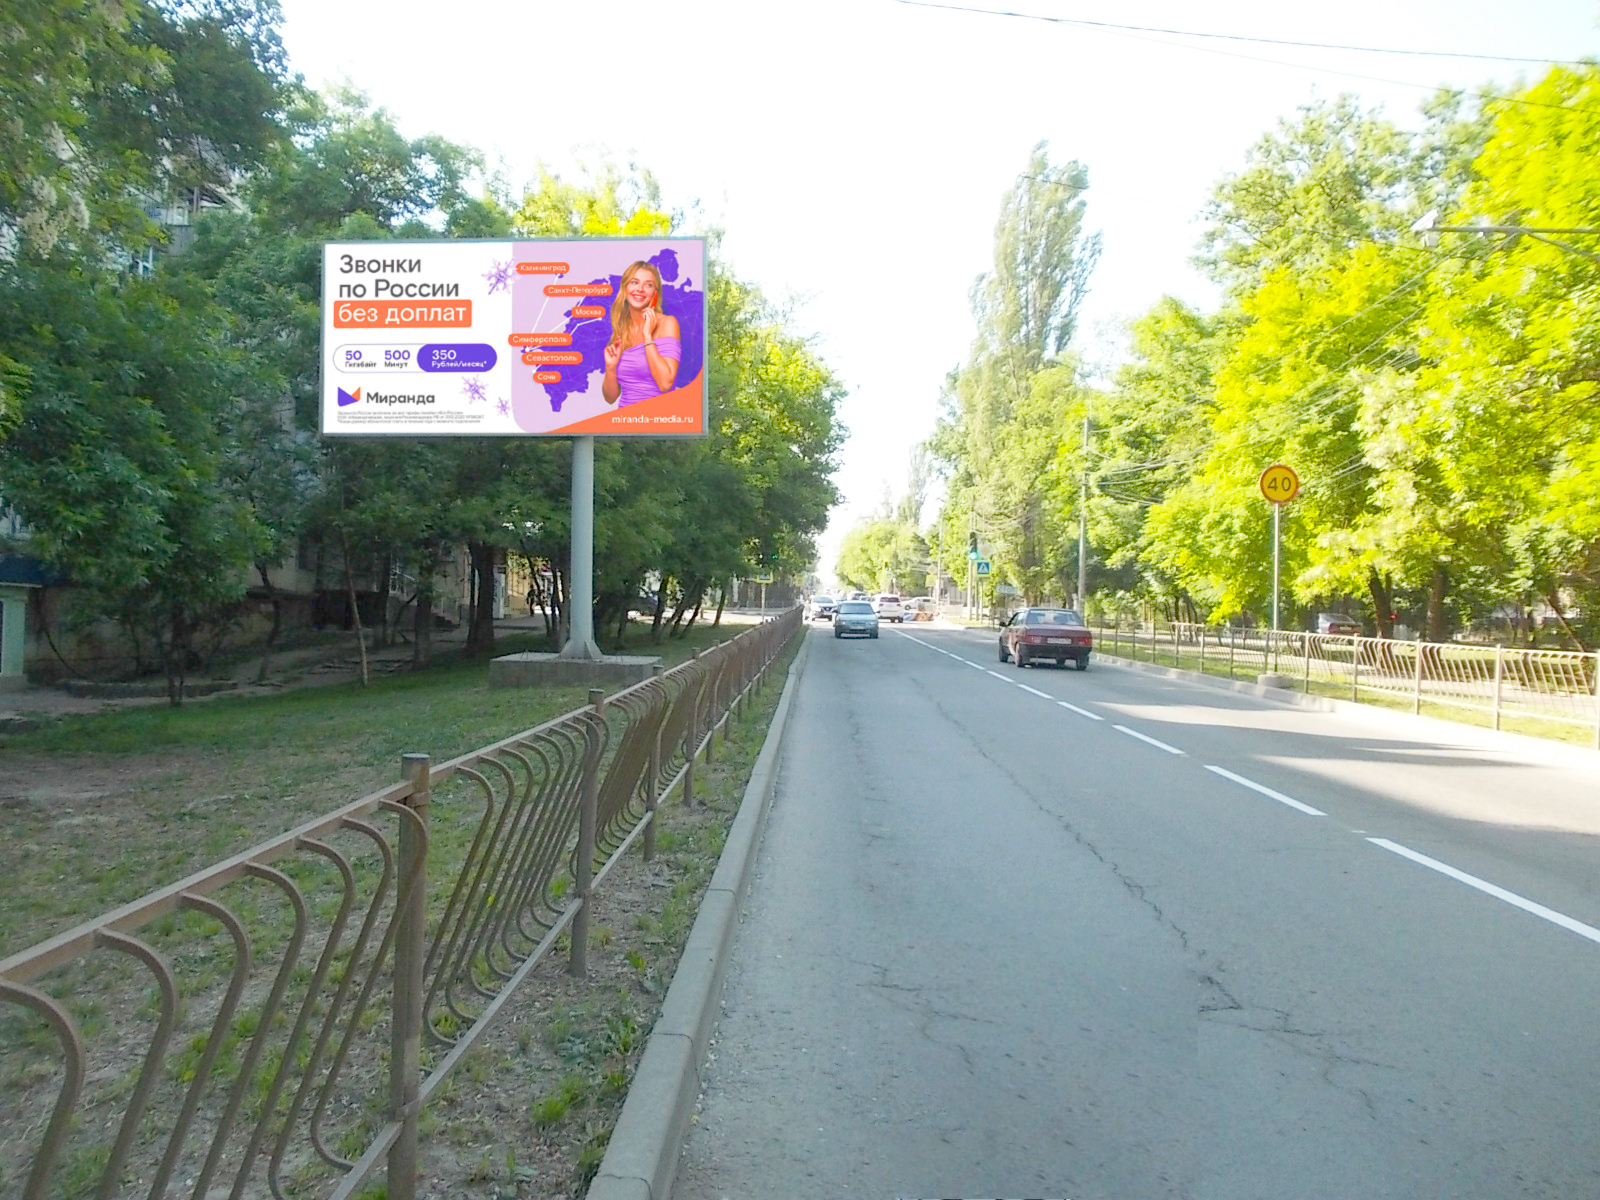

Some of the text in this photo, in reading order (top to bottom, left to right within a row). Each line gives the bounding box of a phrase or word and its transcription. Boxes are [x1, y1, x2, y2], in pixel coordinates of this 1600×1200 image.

[339, 254, 421, 273] Звонки
[520, 263, 566, 272] Калининград
[339, 279, 459, 298] по России
[548, 286, 609, 295] Санкт-Петербург
[338, 303, 467, 325] без доплат
[575, 308, 602, 316] Москва
[512, 335, 567, 345] Симферополь
[345, 349, 457, 361] 50 500 350
[526, 353, 577, 362] Севастополь
[384, 361, 408, 369] Минут
[537, 372, 556, 381] Сочи
[366, 391, 435, 406] Миранда
[611, 414, 694, 424] miranda-media.ru
[1267, 476, 1291, 492] 40
